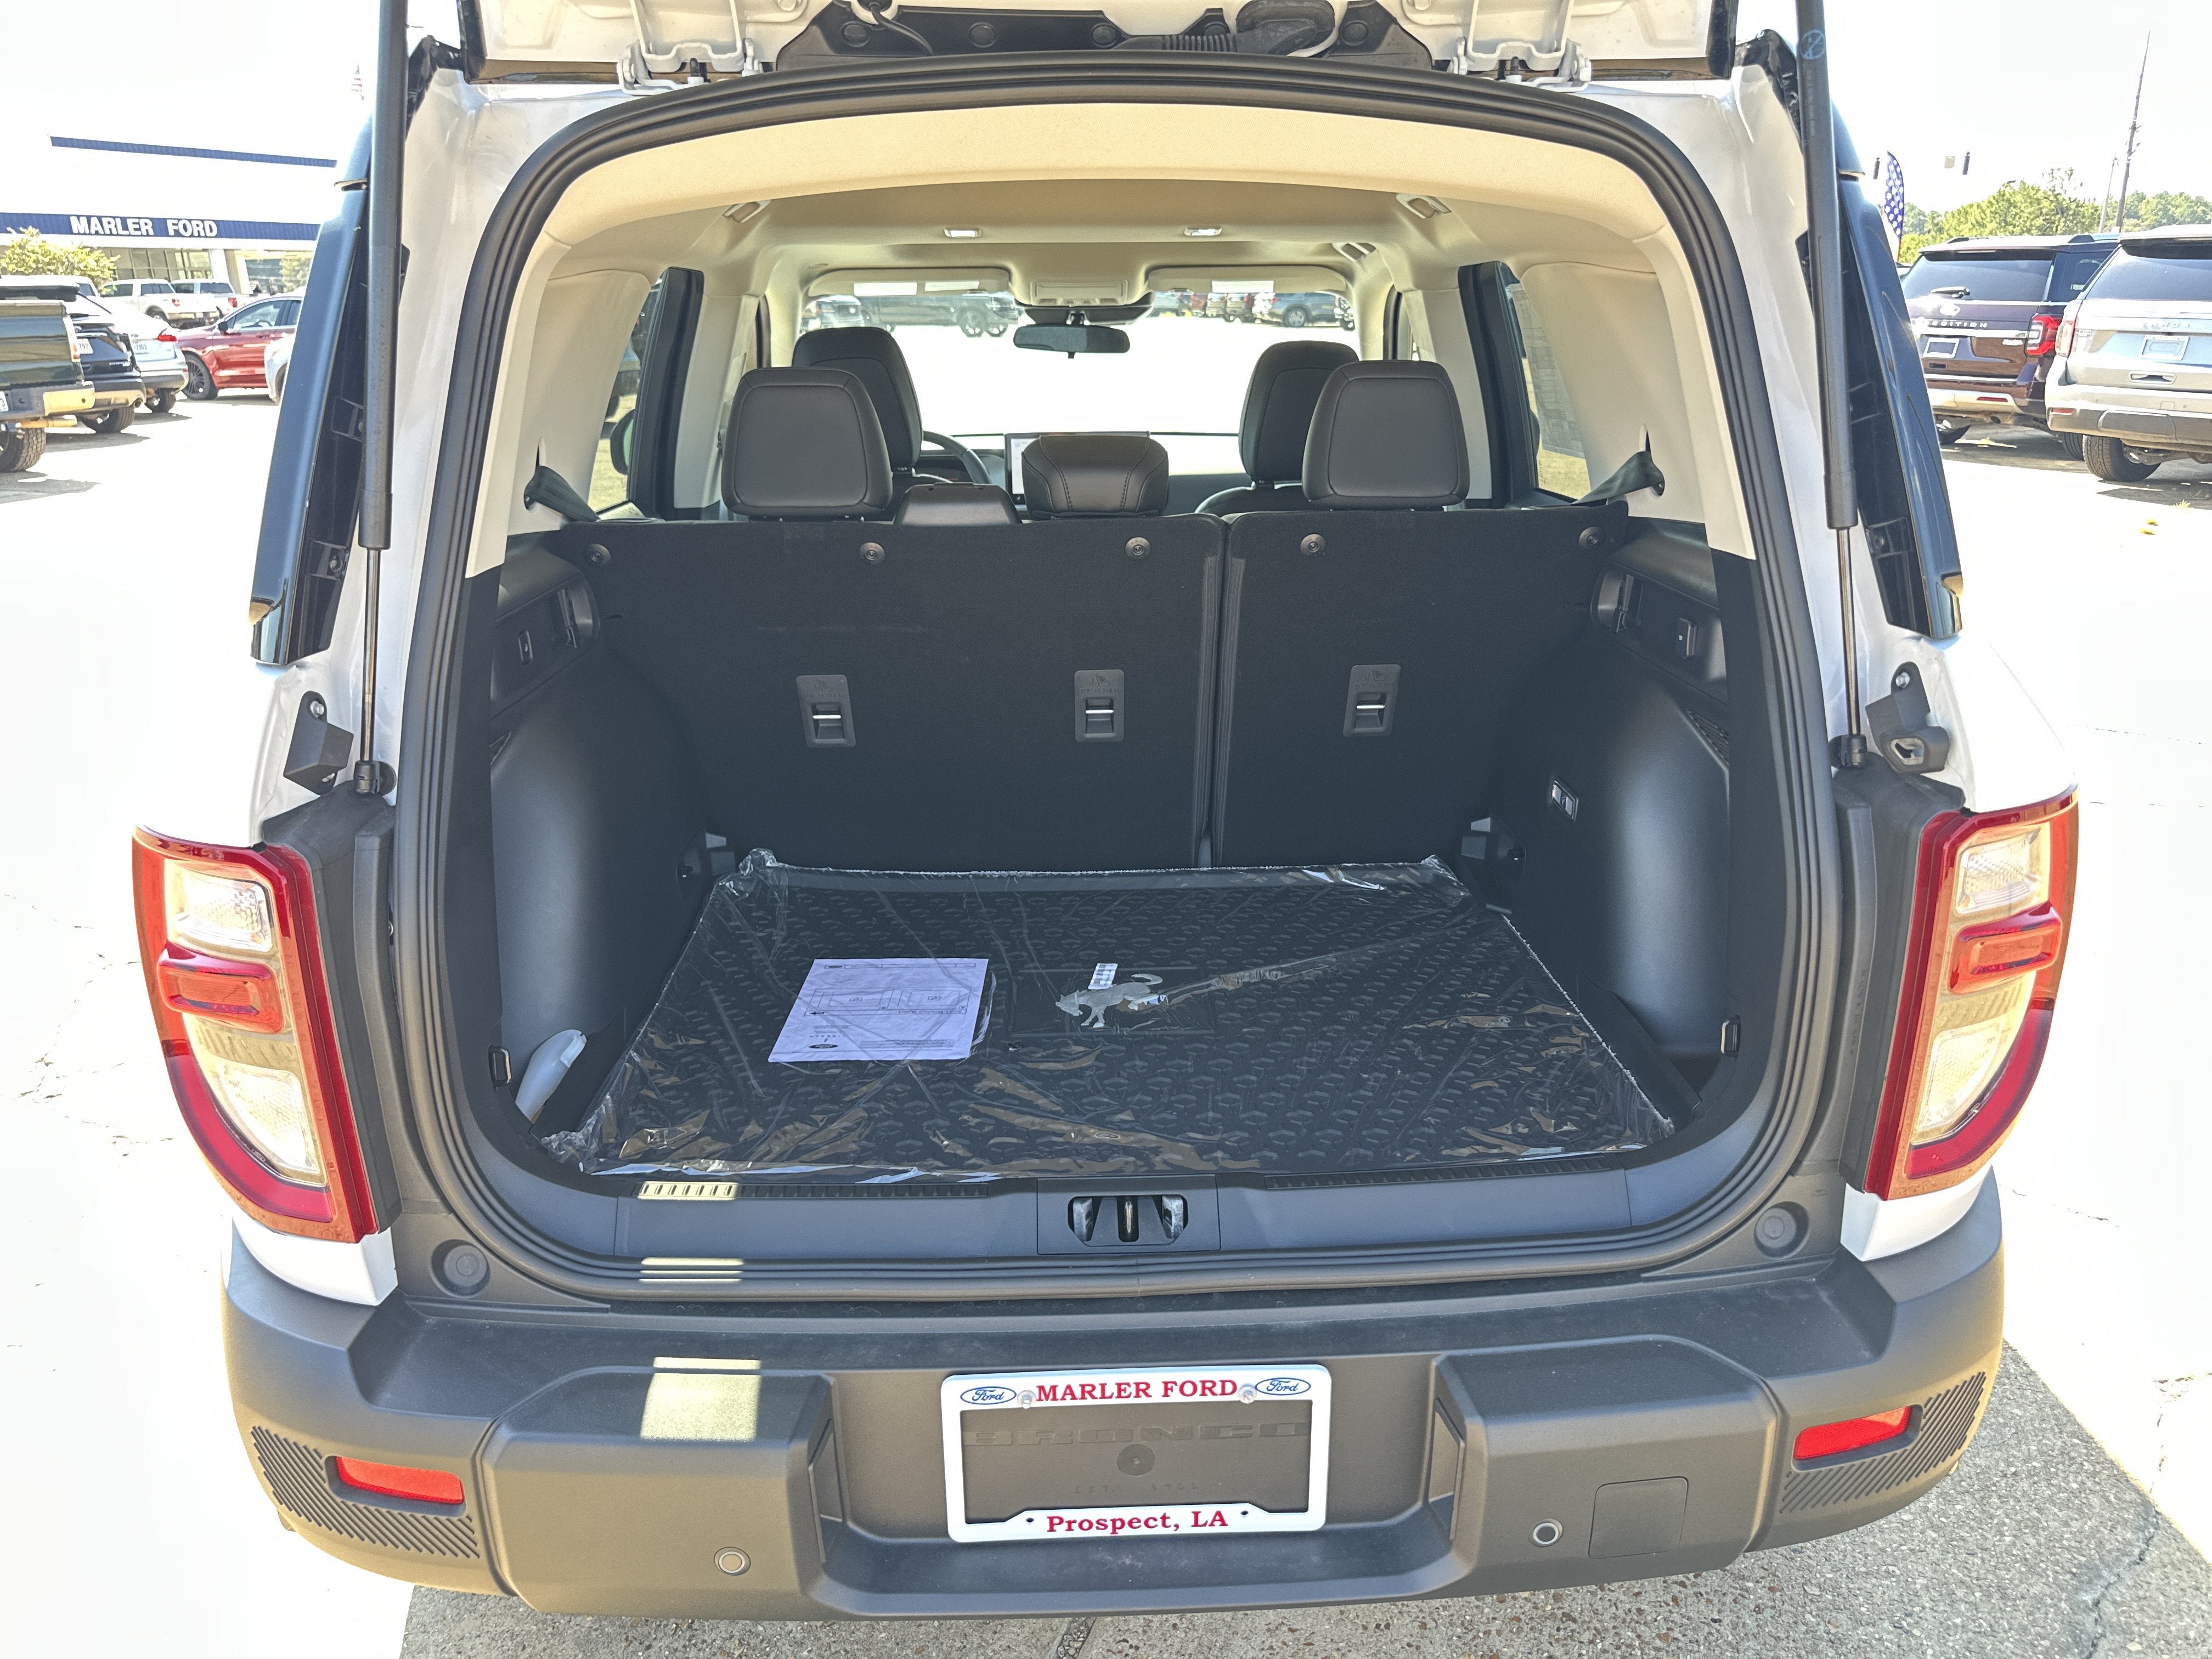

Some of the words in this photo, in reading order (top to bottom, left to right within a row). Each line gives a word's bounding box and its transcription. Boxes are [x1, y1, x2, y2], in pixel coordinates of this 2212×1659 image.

[70, 216, 154, 235] MARLER
[166, 219, 217, 237] FORD
[972, 1389, 1004, 1401] Ford
[1036, 1381, 1153, 1402] MARLER
[1161, 1379, 1238, 1398] FORD
[1266, 1380, 1300, 1392] Ford
[963, 1422, 1311, 1446] BRONCO
[1046, 1512, 1180, 1535] Prospect,
[1190, 1510, 1228, 1527] LA
